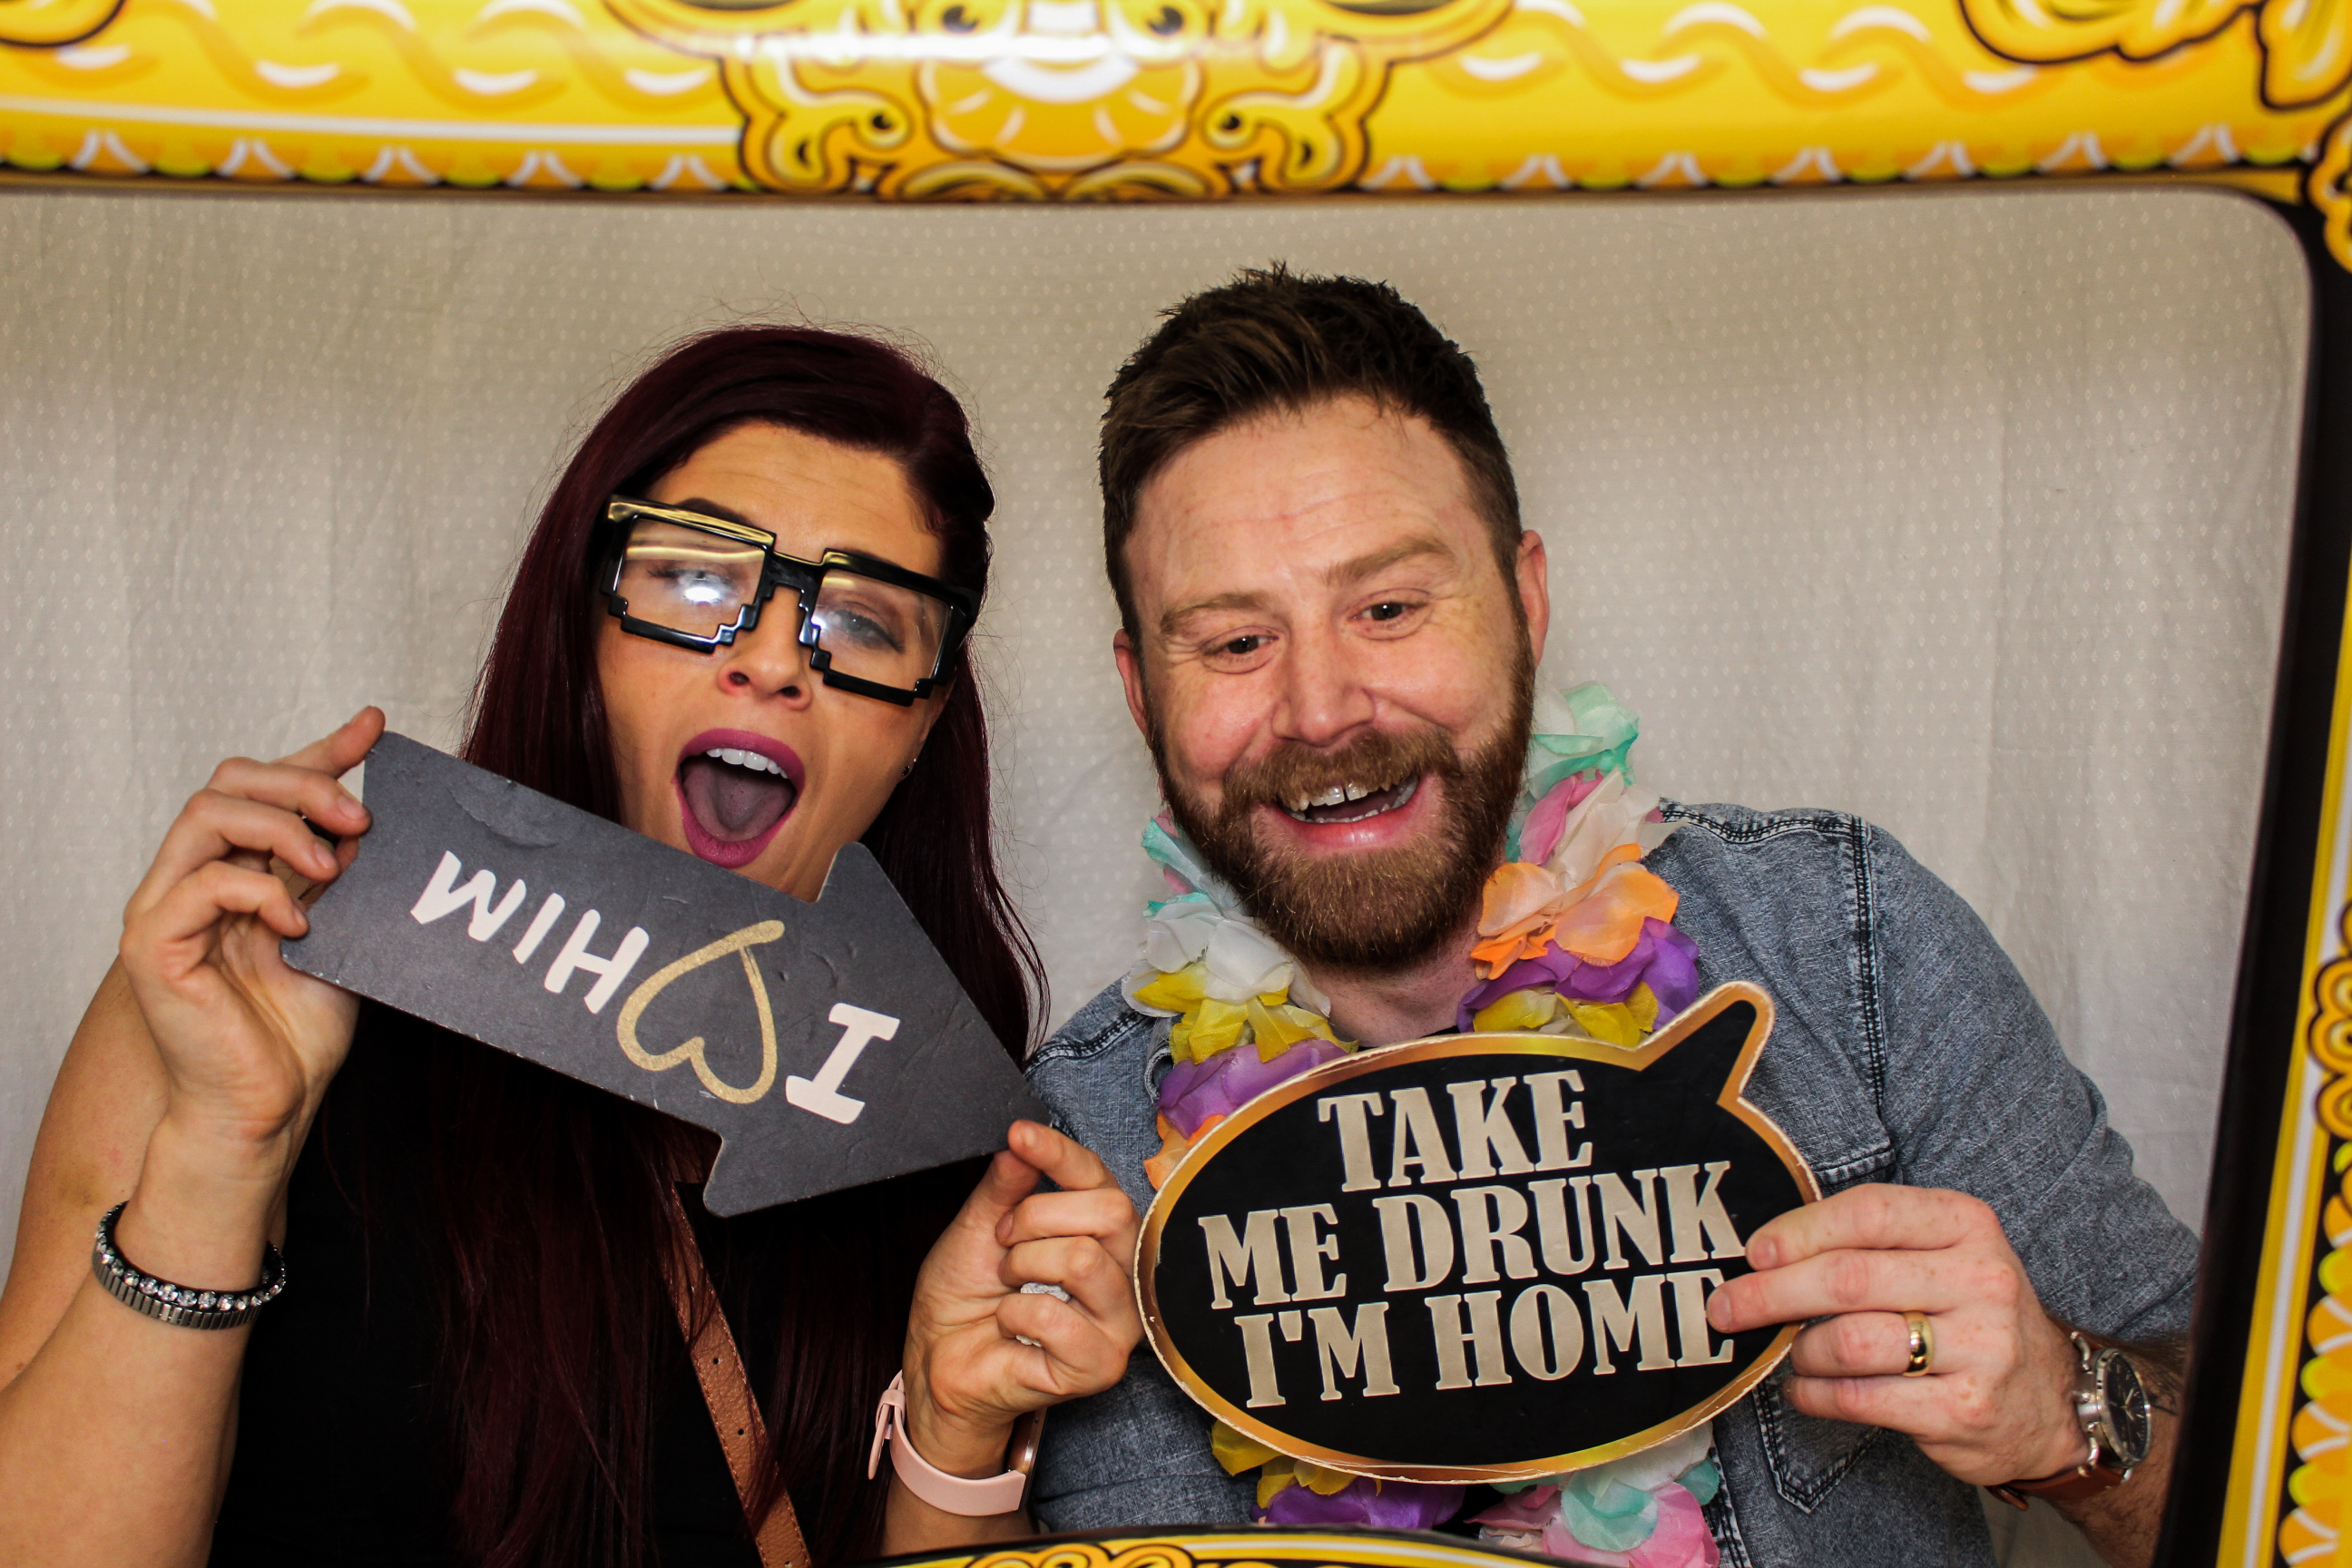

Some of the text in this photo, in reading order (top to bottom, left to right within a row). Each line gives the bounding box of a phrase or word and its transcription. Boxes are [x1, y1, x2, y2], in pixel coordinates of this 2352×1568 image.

[1318, 1069, 1592, 1192] TAKE
[1198, 1160, 1747, 1309] ME DRUNK
[1234, 1268, 1734, 1408] I'M HOME
